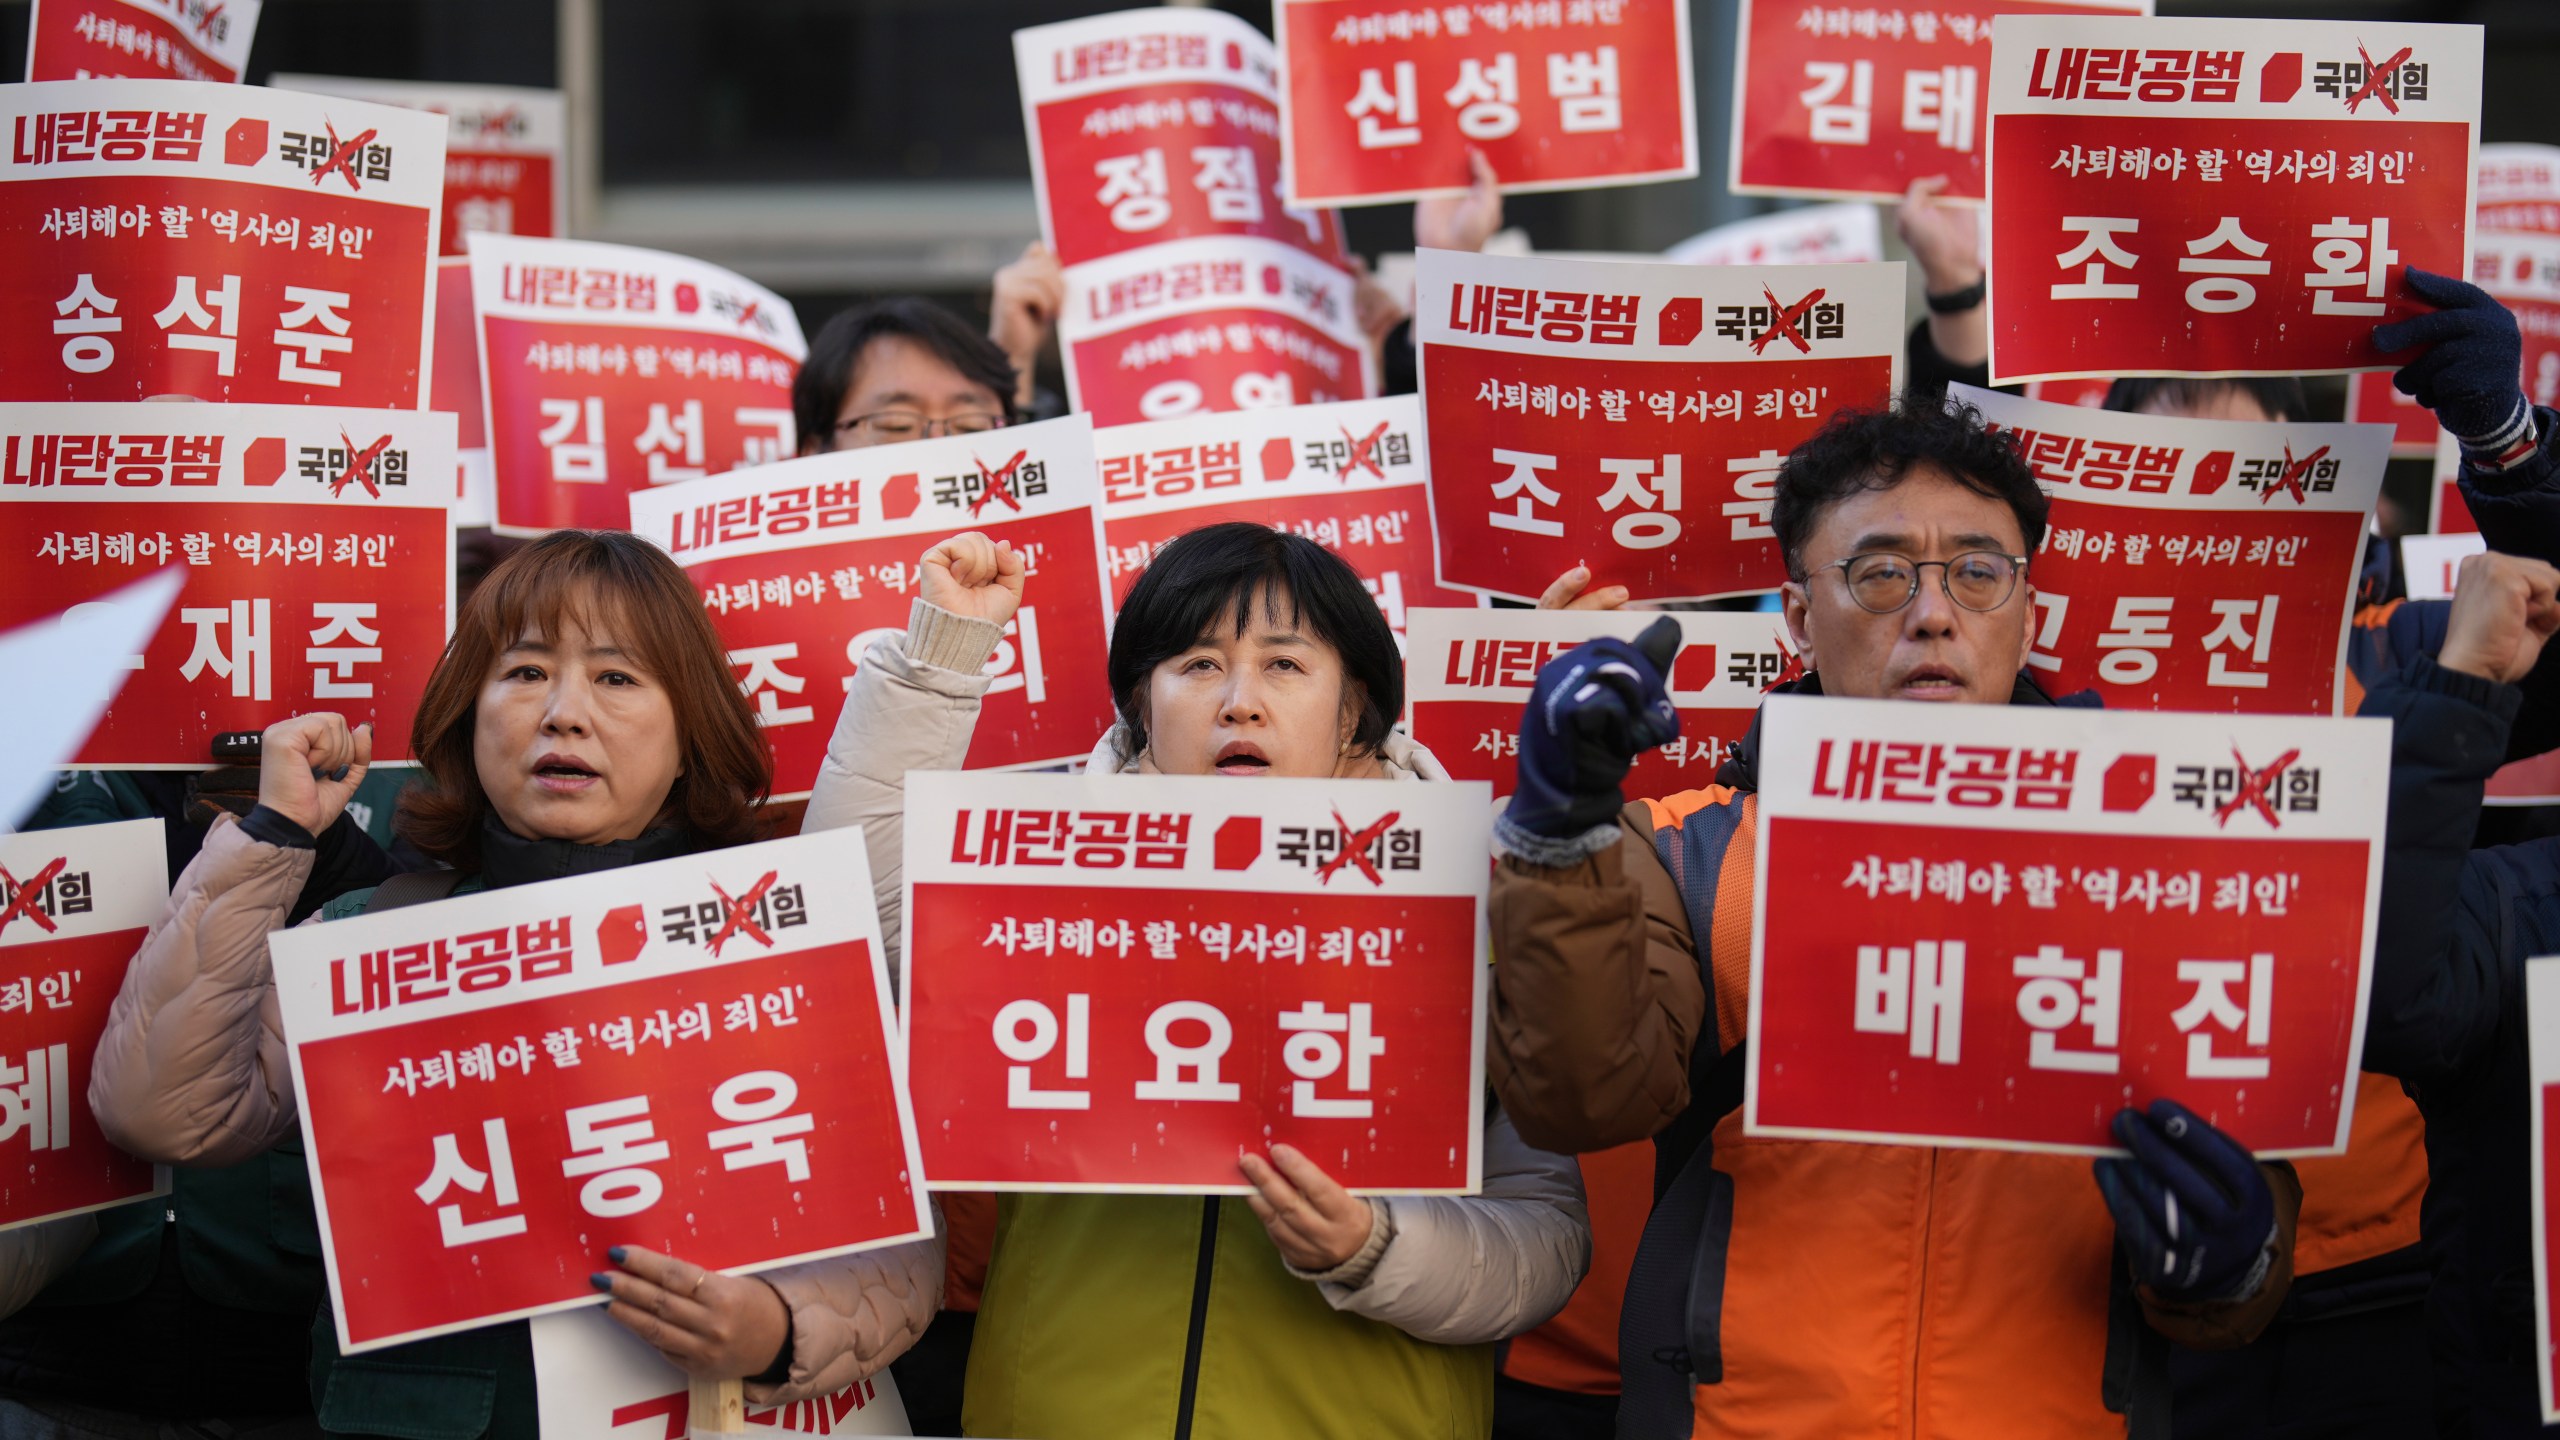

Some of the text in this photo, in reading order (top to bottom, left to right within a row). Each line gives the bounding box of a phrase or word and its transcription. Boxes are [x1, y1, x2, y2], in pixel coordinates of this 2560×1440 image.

[1799, 59, 1979, 152] 김태
[2027, 47, 2245, 103] 내란공범
[12, 111, 207, 166] 내란공범
[1448, 283, 1641, 346] 내란공범
[3, 435, 224, 488] 내란공범
[1097, 441, 1242, 504] 란공범
[672, 480, 860, 554] 내란공범
[1810, 739, 2080, 812] 내란공범
[950, 808, 1193, 870] 내란공범
[331, 916, 573, 1017] 내란공범
